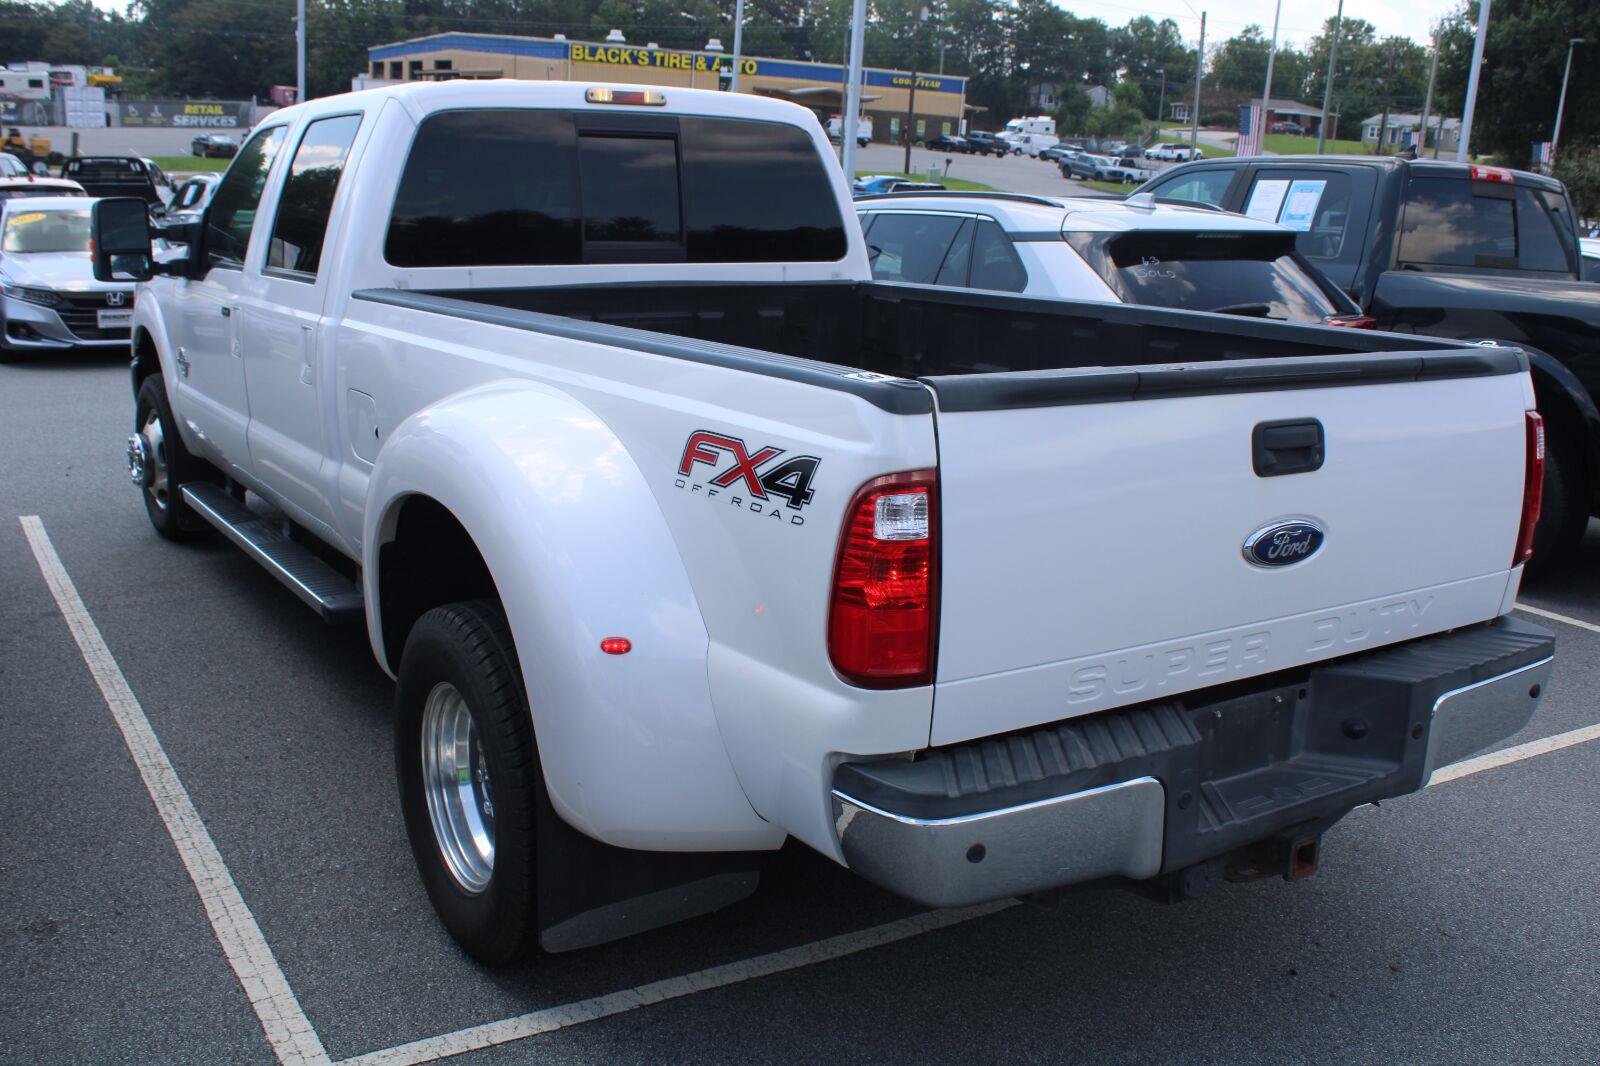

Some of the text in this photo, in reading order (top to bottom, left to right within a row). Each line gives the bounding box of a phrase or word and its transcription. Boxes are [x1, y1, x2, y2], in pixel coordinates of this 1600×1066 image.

[571, 44, 650, 66] BLACK'S
[653, 52, 692, 69] TIRE
[695, 57, 707, 71] &
[712, 56, 757, 75] ATO
[173, 114, 237, 127] SERVICES
[184, 104, 224, 115] RETAIL
[678, 429, 822, 511] FX4
[675, 478, 805, 525] OFF ROAD
[1267, 529, 1312, 559] Ford
[1066, 595, 1435, 705] SUPER DUTY
